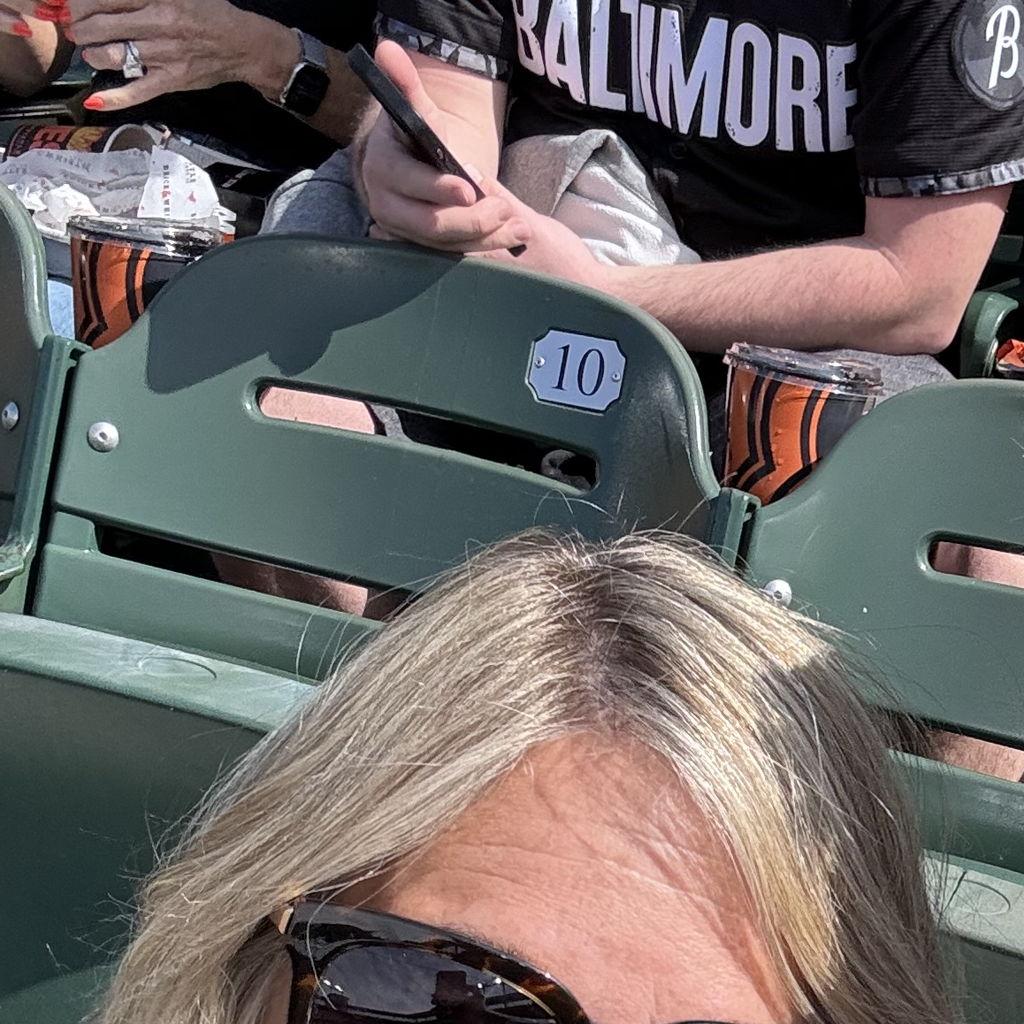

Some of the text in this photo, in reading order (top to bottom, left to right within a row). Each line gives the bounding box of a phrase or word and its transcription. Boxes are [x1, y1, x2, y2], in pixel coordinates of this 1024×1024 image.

[512, 0, 857, 153] BALTIMORE
[985, 4, 1021, 89] B
[552, 343, 605, 396] 10
